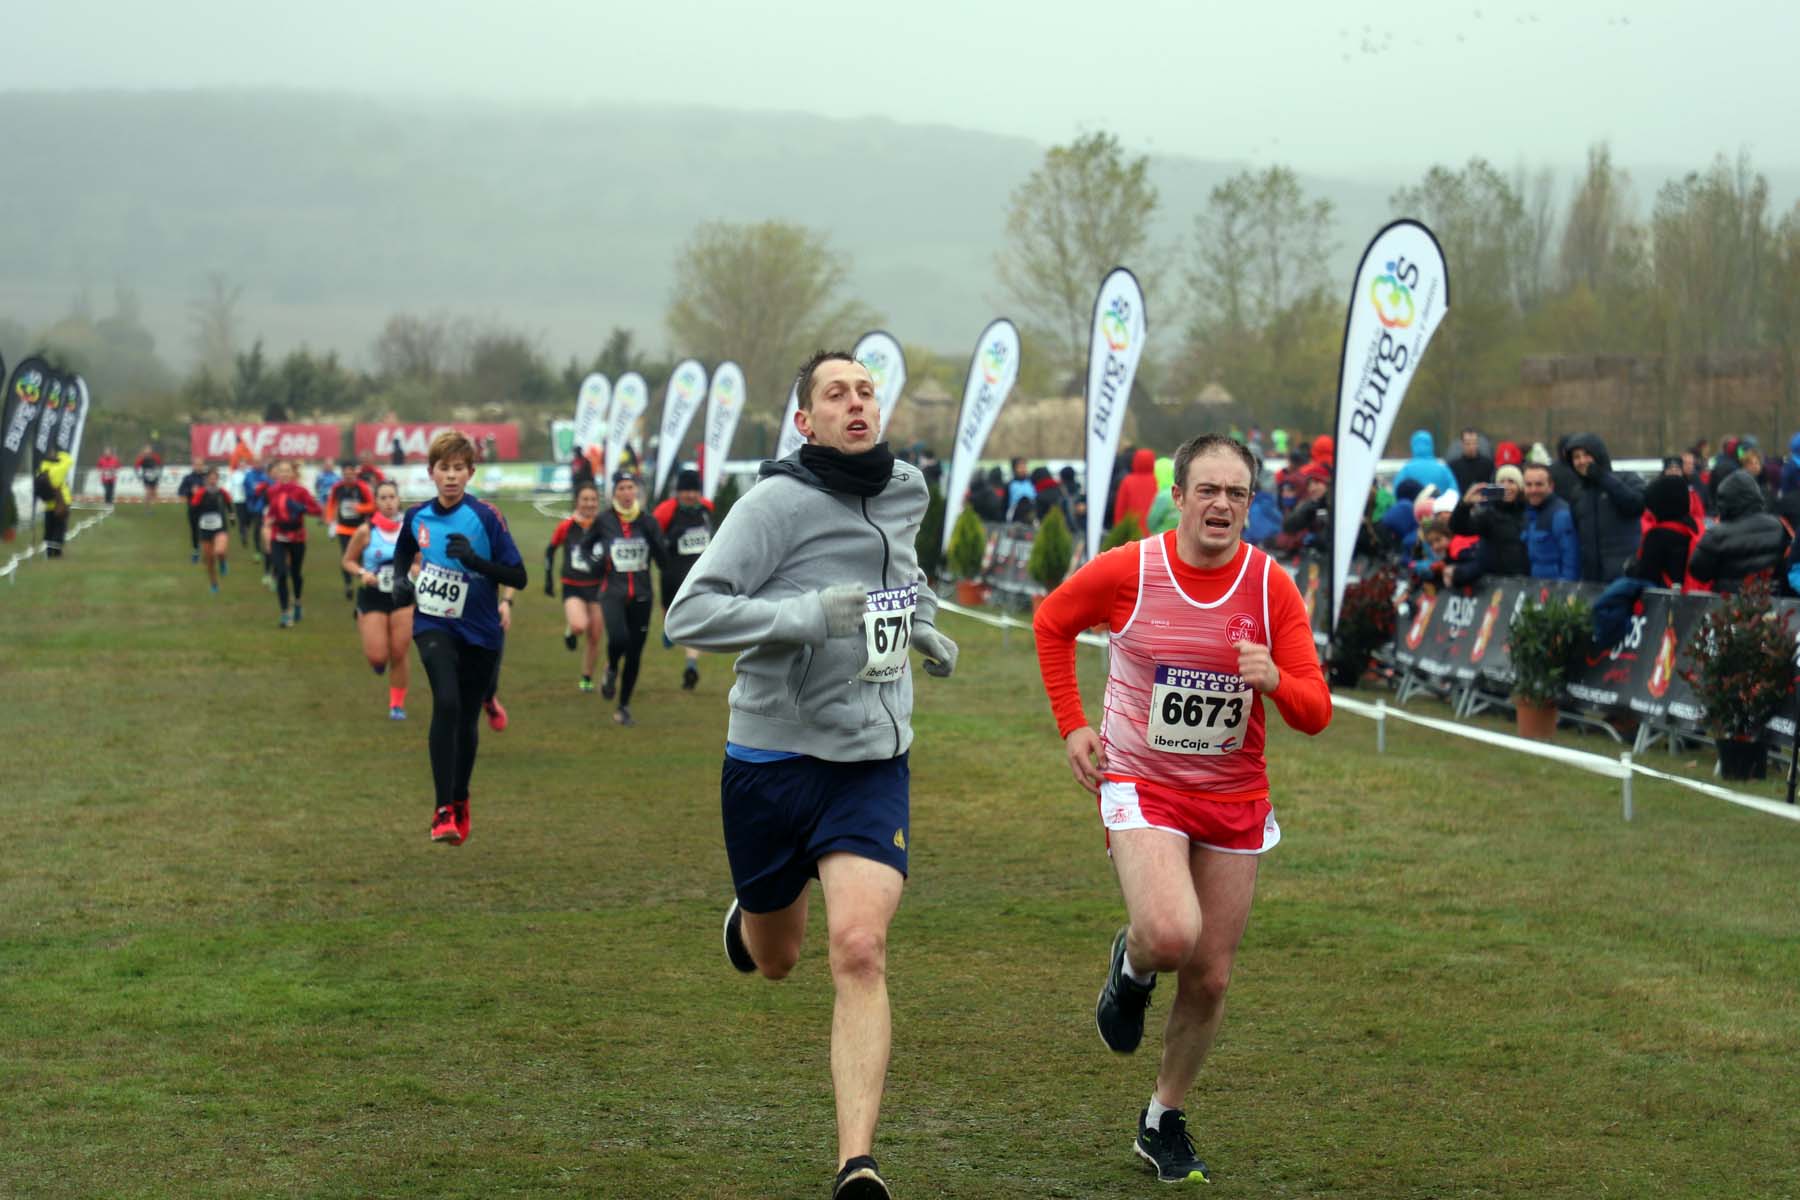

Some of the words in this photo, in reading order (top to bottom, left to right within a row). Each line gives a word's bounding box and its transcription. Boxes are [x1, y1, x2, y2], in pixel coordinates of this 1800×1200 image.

[418, 576, 460, 602] 6449
[1166, 676, 1246, 693] BURGOS
[1161, 691, 1244, 729] 6673
[1154, 735, 1210, 751] iberCaja
